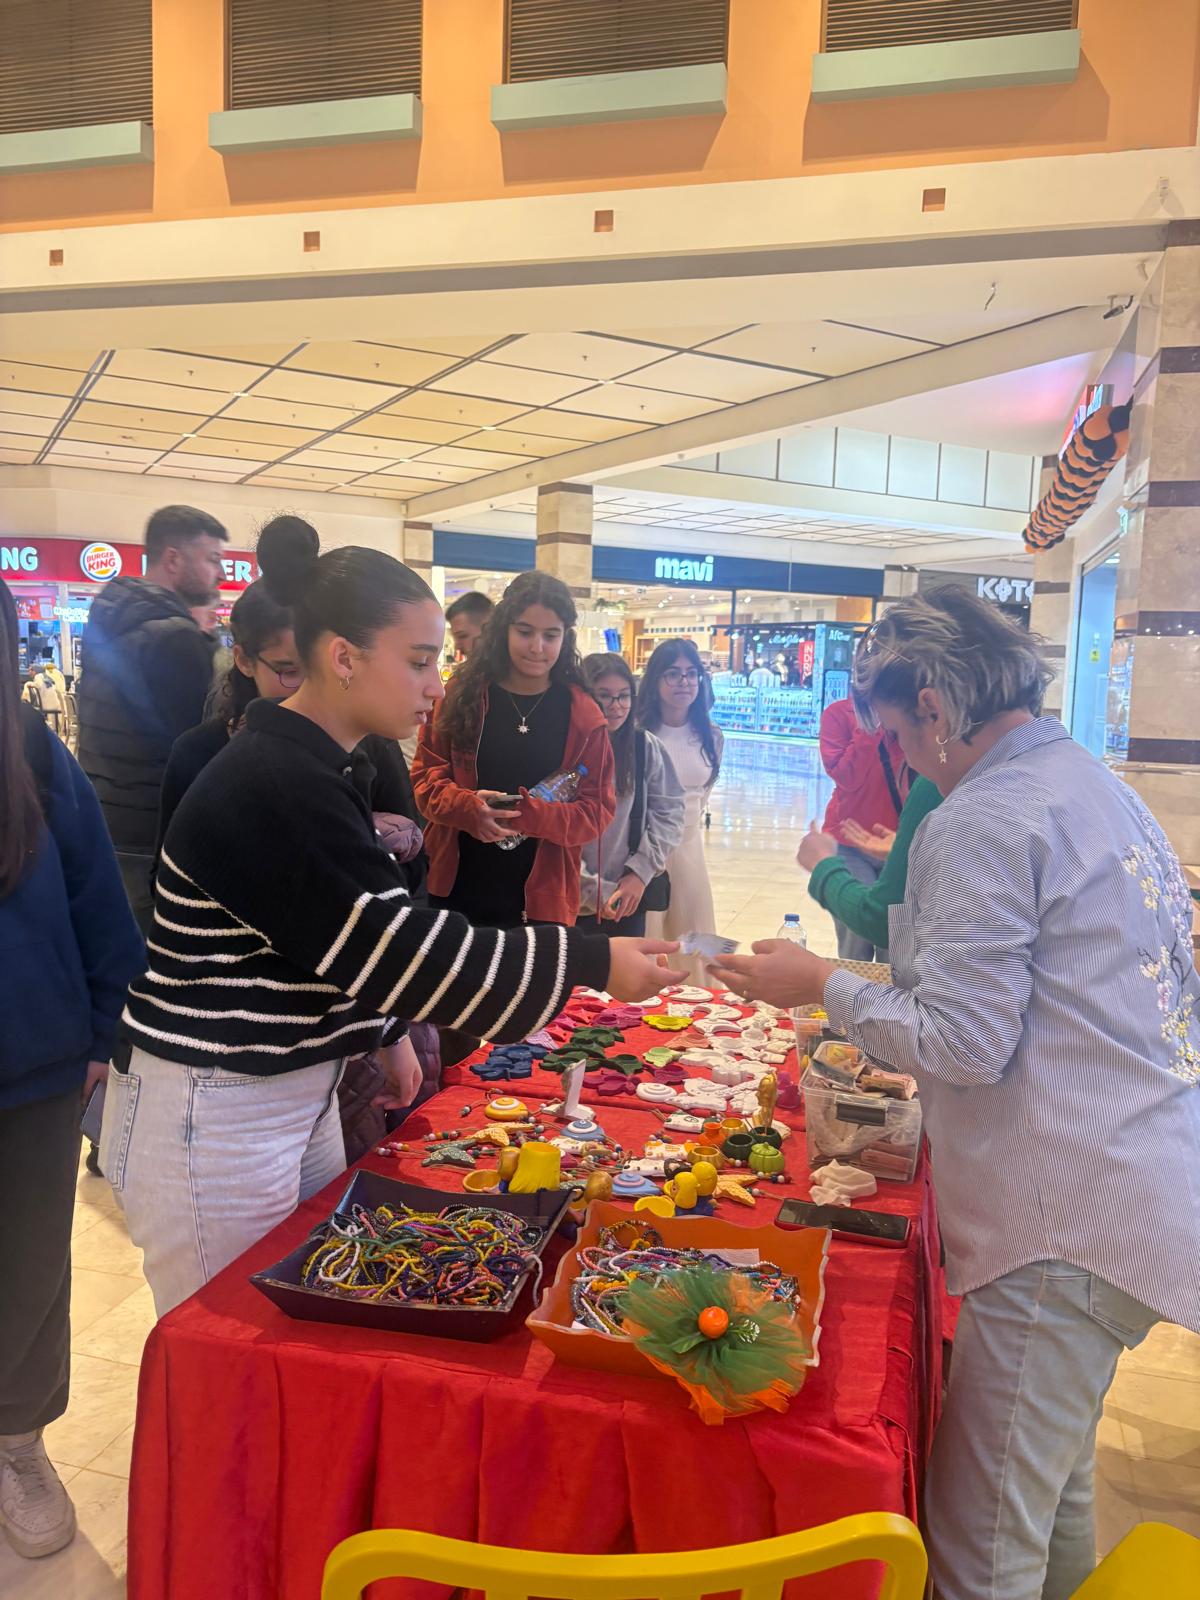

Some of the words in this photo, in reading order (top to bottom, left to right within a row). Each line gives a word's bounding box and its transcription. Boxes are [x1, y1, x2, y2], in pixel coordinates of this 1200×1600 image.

[86, 551, 115, 563] BURGER
[87, 557, 116, 573] KING
[655, 555, 714, 582] mavi
